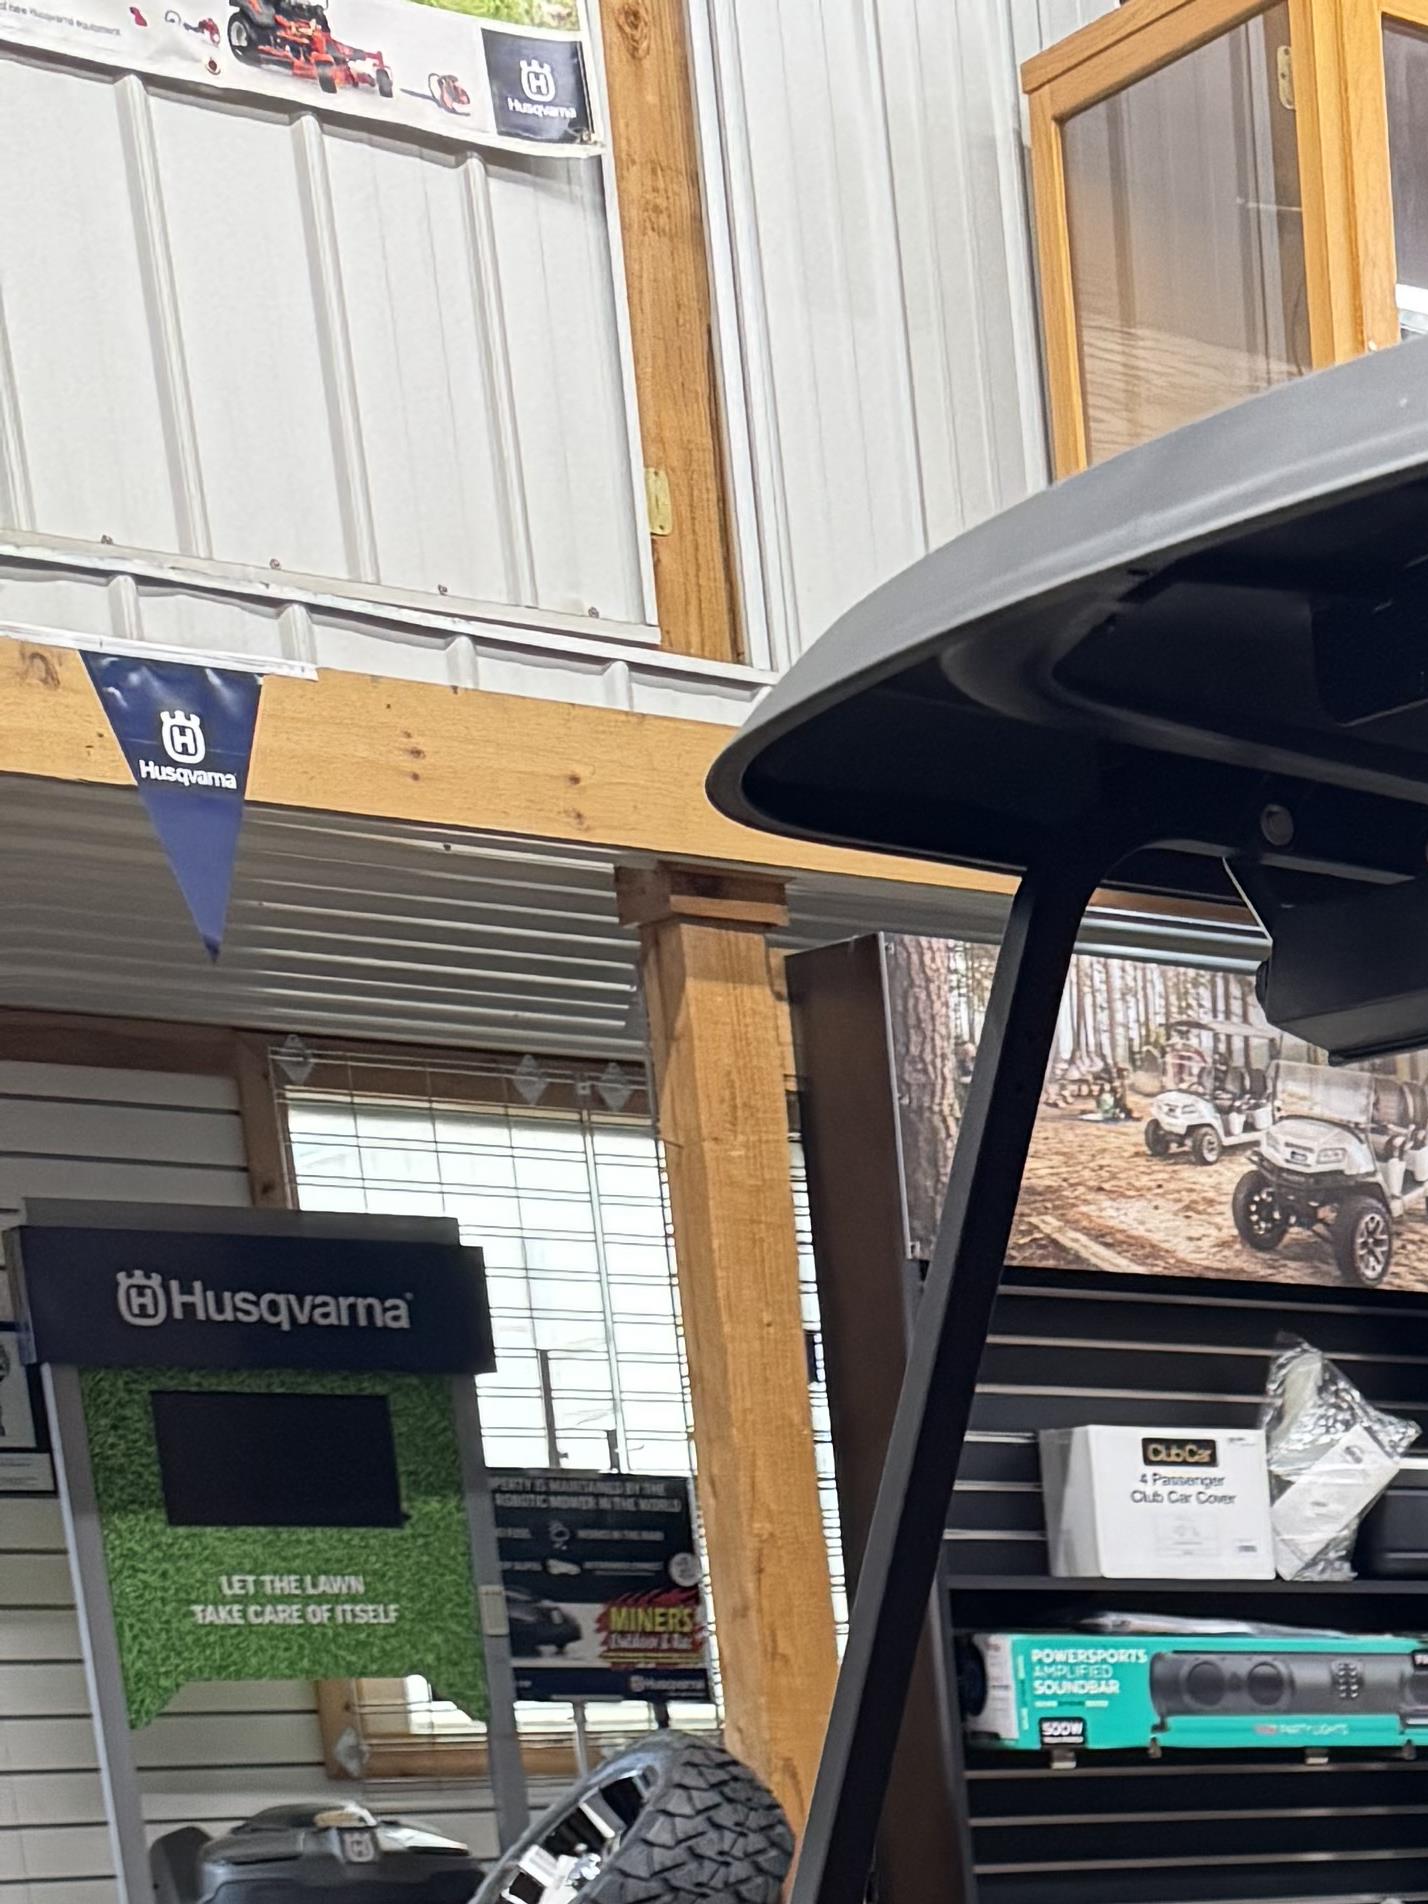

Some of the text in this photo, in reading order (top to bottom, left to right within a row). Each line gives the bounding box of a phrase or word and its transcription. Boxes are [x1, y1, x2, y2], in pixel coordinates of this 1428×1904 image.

[507, 97, 577, 118] Husqvarna
[139, 759, 238, 790] Husqvarna
[169, 1278, 412, 1332] Husqvarna
[1152, 1473, 1226, 1490] Passenger
[1130, 1489, 1237, 1505] Club Car Cover
[220, 1574, 366, 1596] LET THE LAWN
[190, 1603, 401, 1625] TAKE CARE OF ITSELF
[1031, 1648, 1149, 1664] POWERSPORTS
[1033, 1664, 1114, 1680] AMPLIFIED
[1033, 1679, 1121, 1696] SOUNDBAR
[1041, 1720, 1084, 1737] 500W
